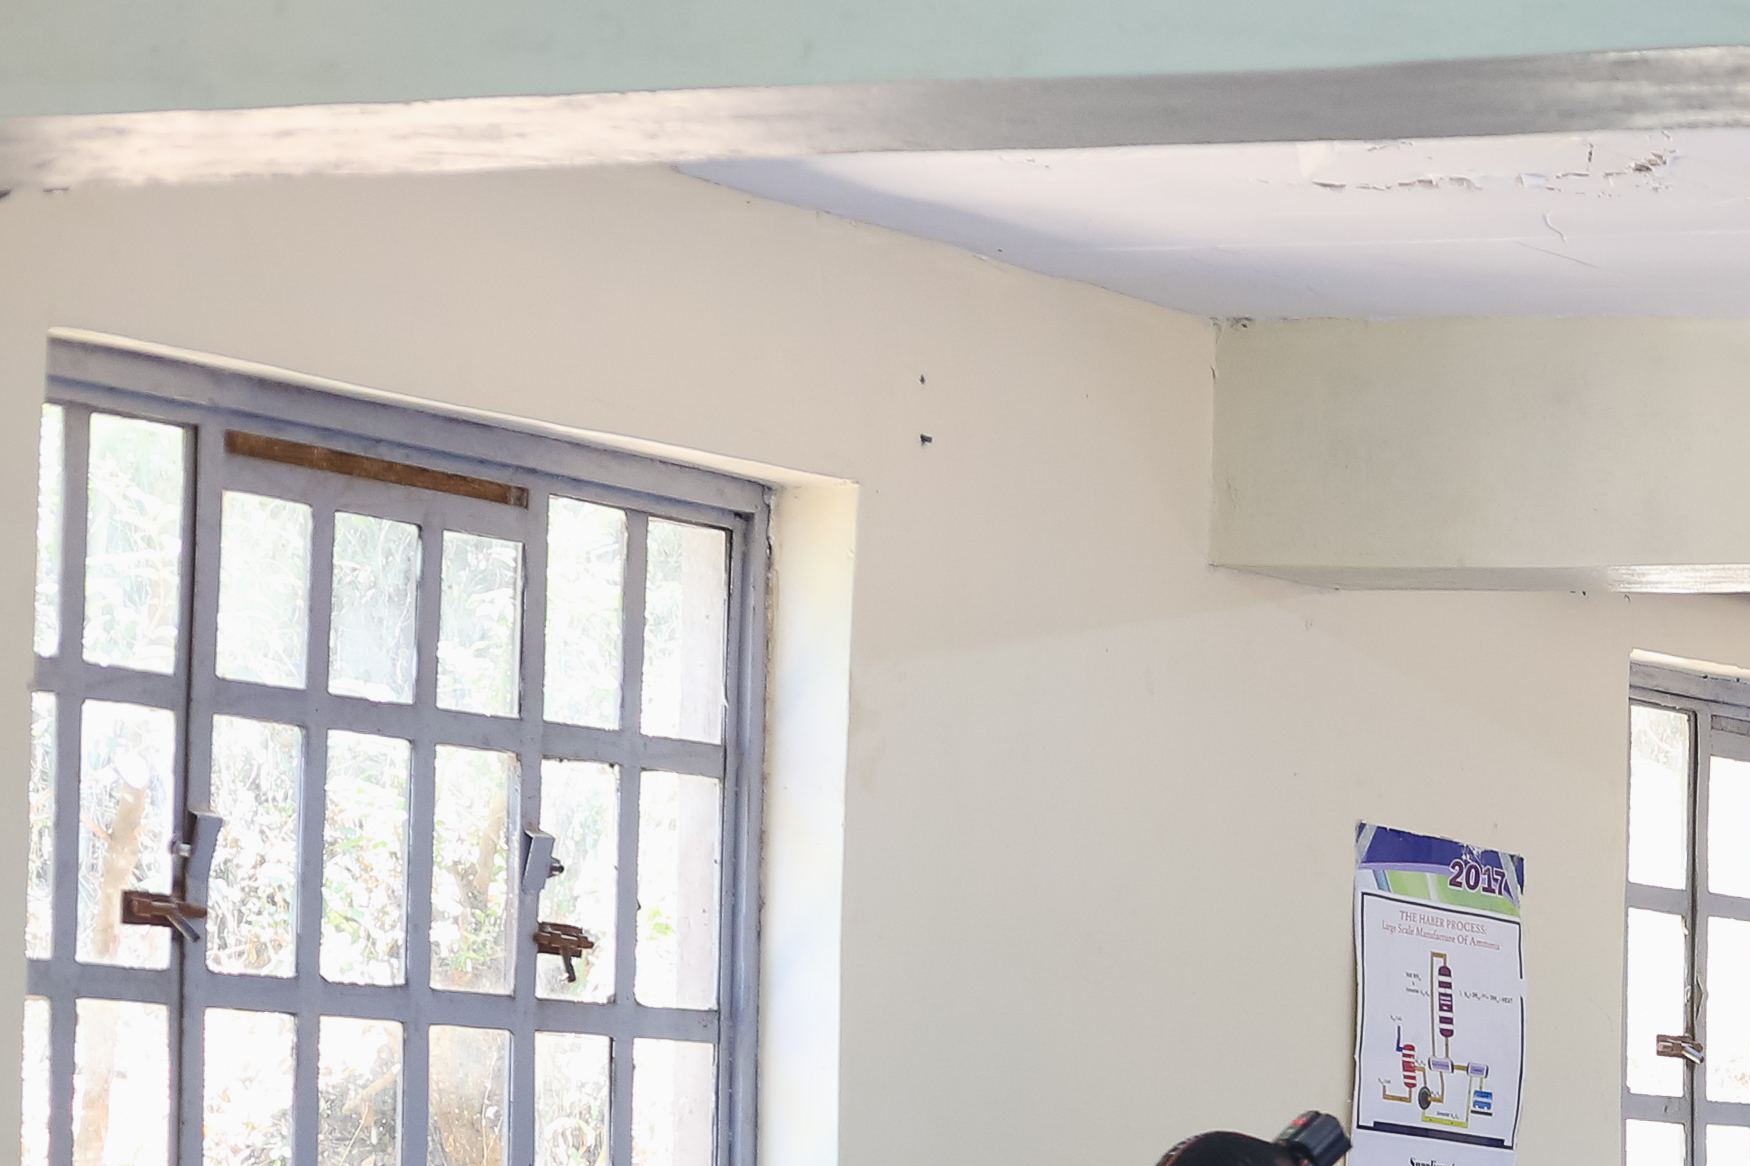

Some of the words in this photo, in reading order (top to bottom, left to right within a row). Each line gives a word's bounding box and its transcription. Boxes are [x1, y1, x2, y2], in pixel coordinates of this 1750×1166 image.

[1448, 860, 1506, 896] 2017
[1382, 920, 1396, 935] Large
[1398, 924, 1414, 936] Scale
[1399, 910, 1417, 923] THE
[1419, 914, 1444, 929] HABER
